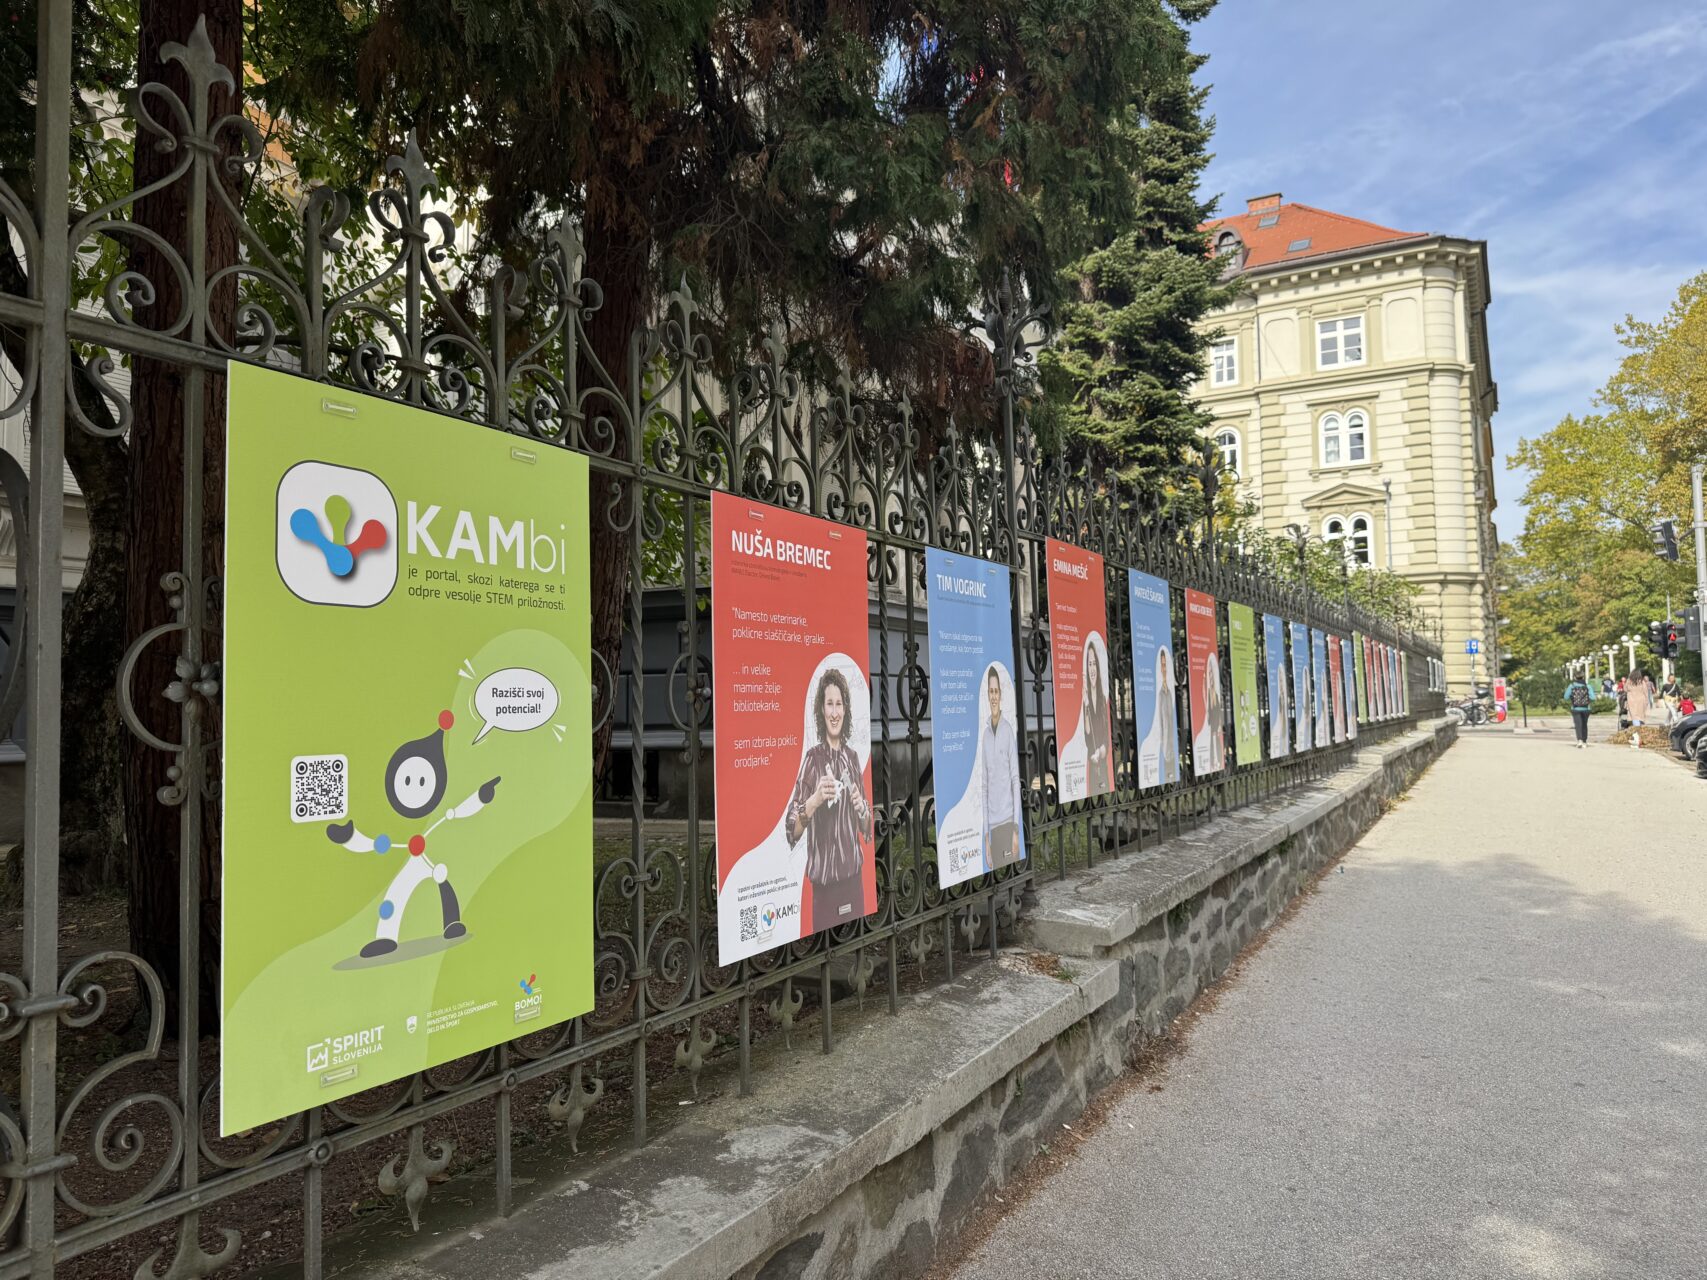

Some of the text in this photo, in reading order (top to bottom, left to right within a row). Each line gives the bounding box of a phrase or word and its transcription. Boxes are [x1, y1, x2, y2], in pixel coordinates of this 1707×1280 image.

[408, 500, 565, 575] KAMbi
[732, 529, 773, 559] NUŠA
[777, 540, 831, 570] BREMEC
[1054, 559, 1071, 573] EMINA
[1073, 563, 1088, 580] MEŠIĆ
[408, 565, 565, 594] je portal, skozi katerega se ti
[936, 574, 987, 598] TIM VOGRINC
[408, 585, 566, 610] odpre vesolje STEM priložnosti.
[732, 627, 762, 640] poklicne
[742, 663, 748, 674] in
[750, 664, 771, 675] velike
[492, 687, 544, 700] Razišči svoj
[734, 682, 762, 693] mamine
[496, 704, 541, 716] potencial!
[734, 700, 781, 712] bibliotekarke,
[734, 735, 798, 749] sem izbrala poklic
[515, 994, 542, 1010] BOMO!
[333, 1025, 384, 1054] SPIRIT
[332, 1043, 383, 1064] SLOVENIJA
